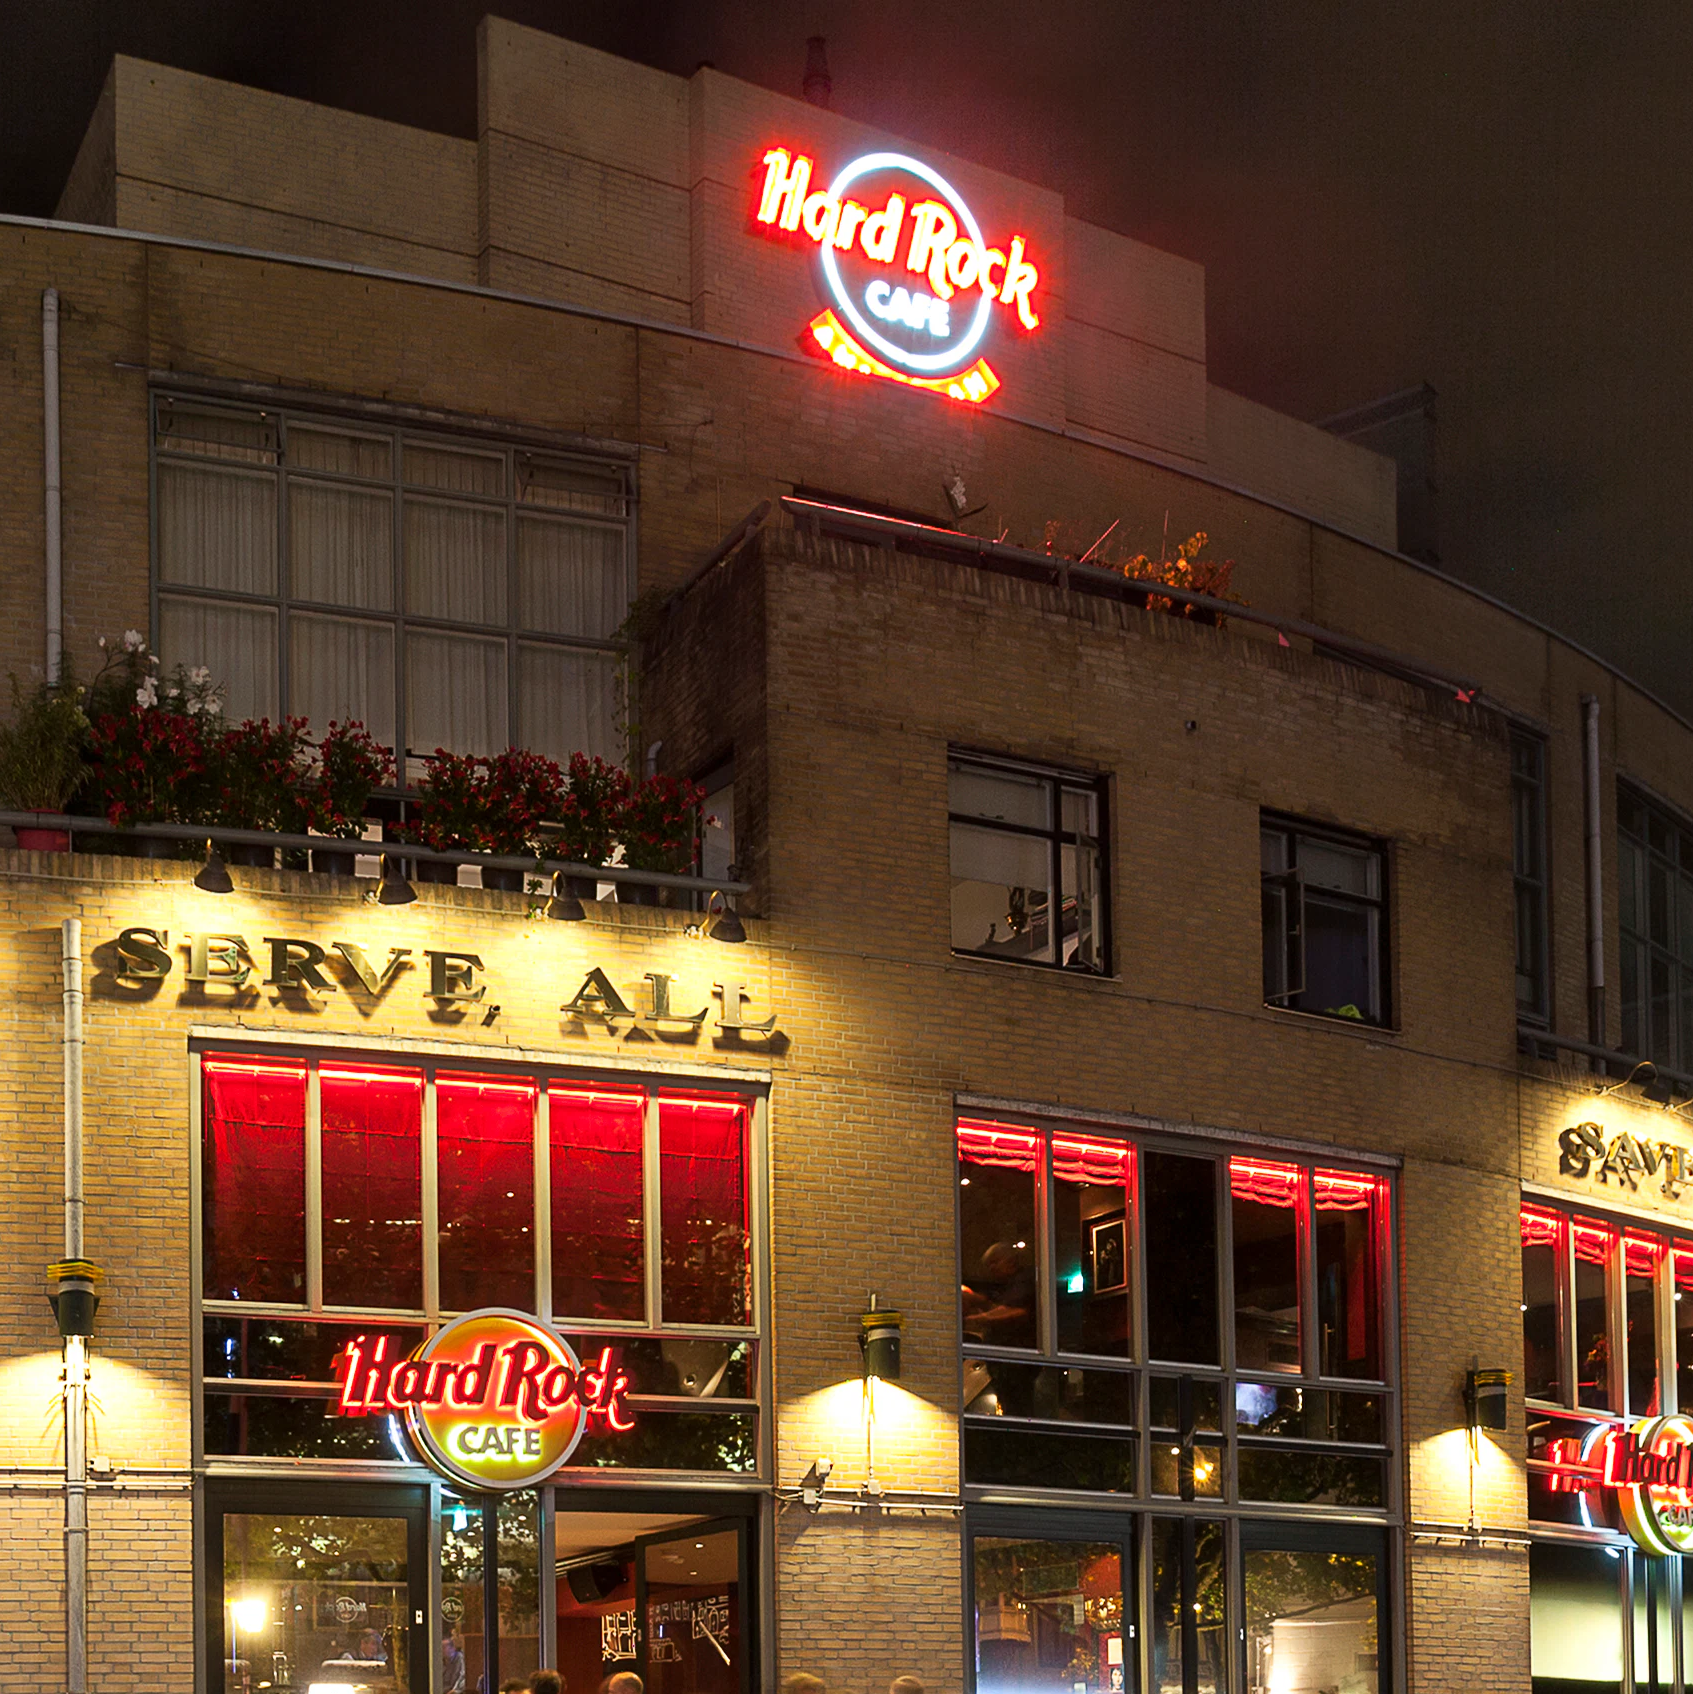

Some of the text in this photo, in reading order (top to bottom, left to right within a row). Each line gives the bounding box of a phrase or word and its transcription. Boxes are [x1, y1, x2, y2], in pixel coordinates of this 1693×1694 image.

[757, 148, 1039, 331] Hard Rock
[865, 279, 950, 337] CAFE
[117, 927, 778, 1032] SERVE, ALL
[341, 1335, 635, 1431] Hard Rock
[457, 1426, 541, 1458] CAFE
[1603, 1430, 1682, 1486] Hard
